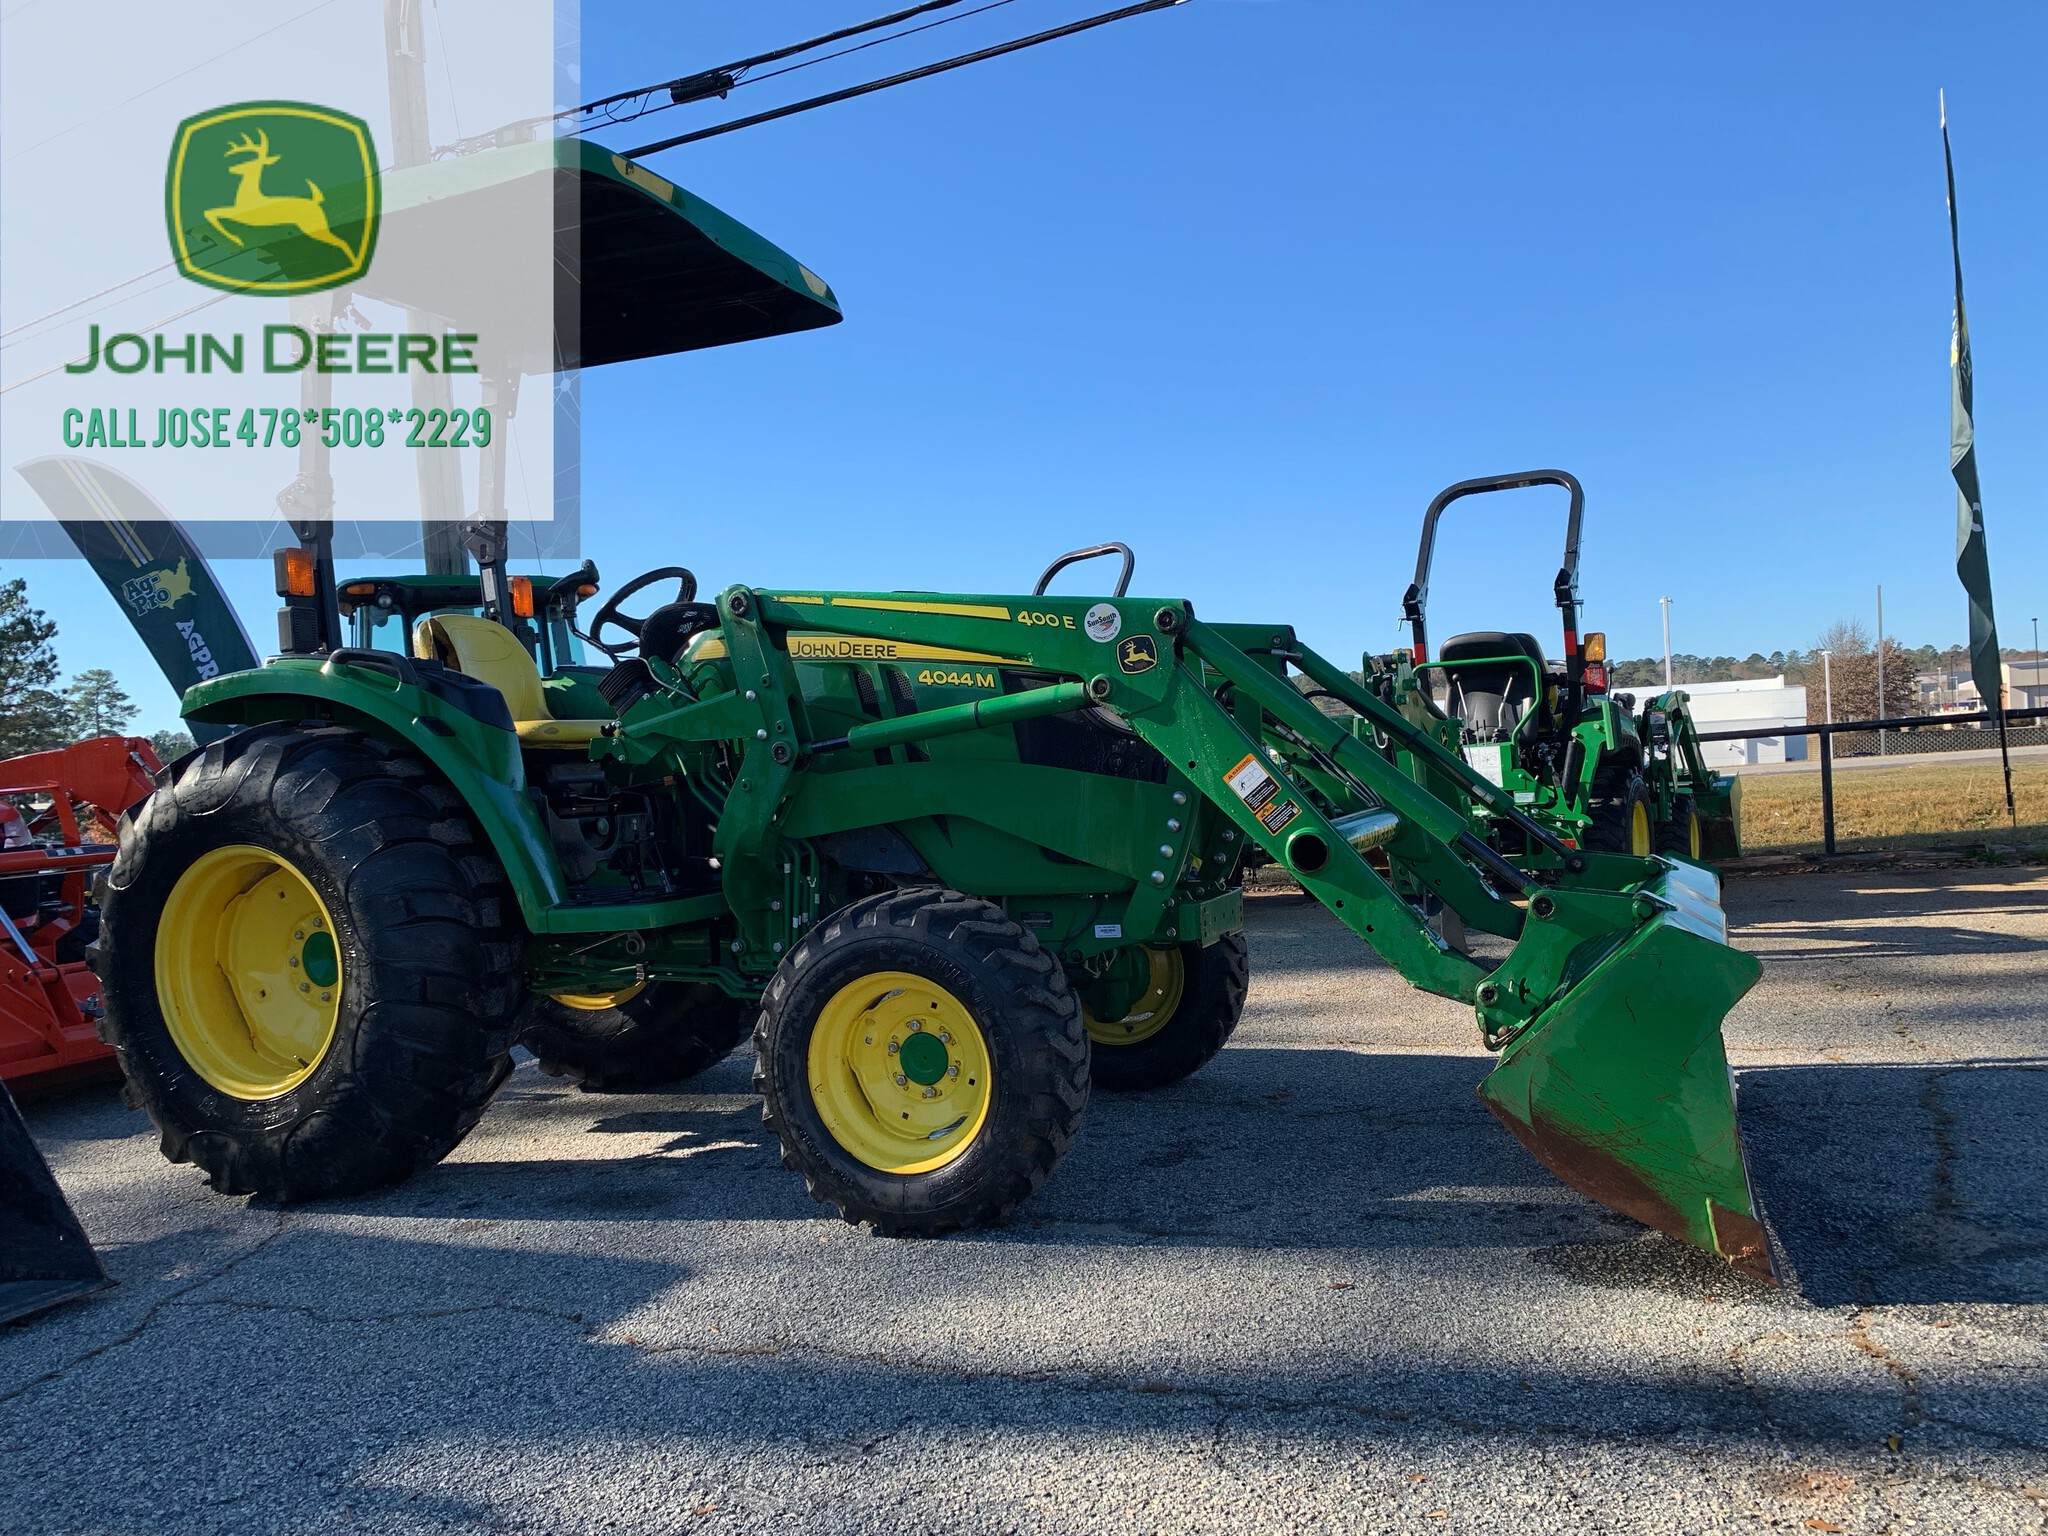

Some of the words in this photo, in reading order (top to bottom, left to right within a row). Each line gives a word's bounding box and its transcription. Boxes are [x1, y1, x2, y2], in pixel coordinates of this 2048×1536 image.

[131, 589, 171, 616] Pro
[1017, 610, 1060, 627] 400
[1062, 615, 1077, 630] E
[1087, 613, 1117, 627] SunSouth
[175, 618, 220, 681] AGPR
[792, 641, 835, 656] JOHN
[839, 641, 897, 657] DEERE
[918, 669, 974, 687] 4044
[975, 672, 995, 689] M
